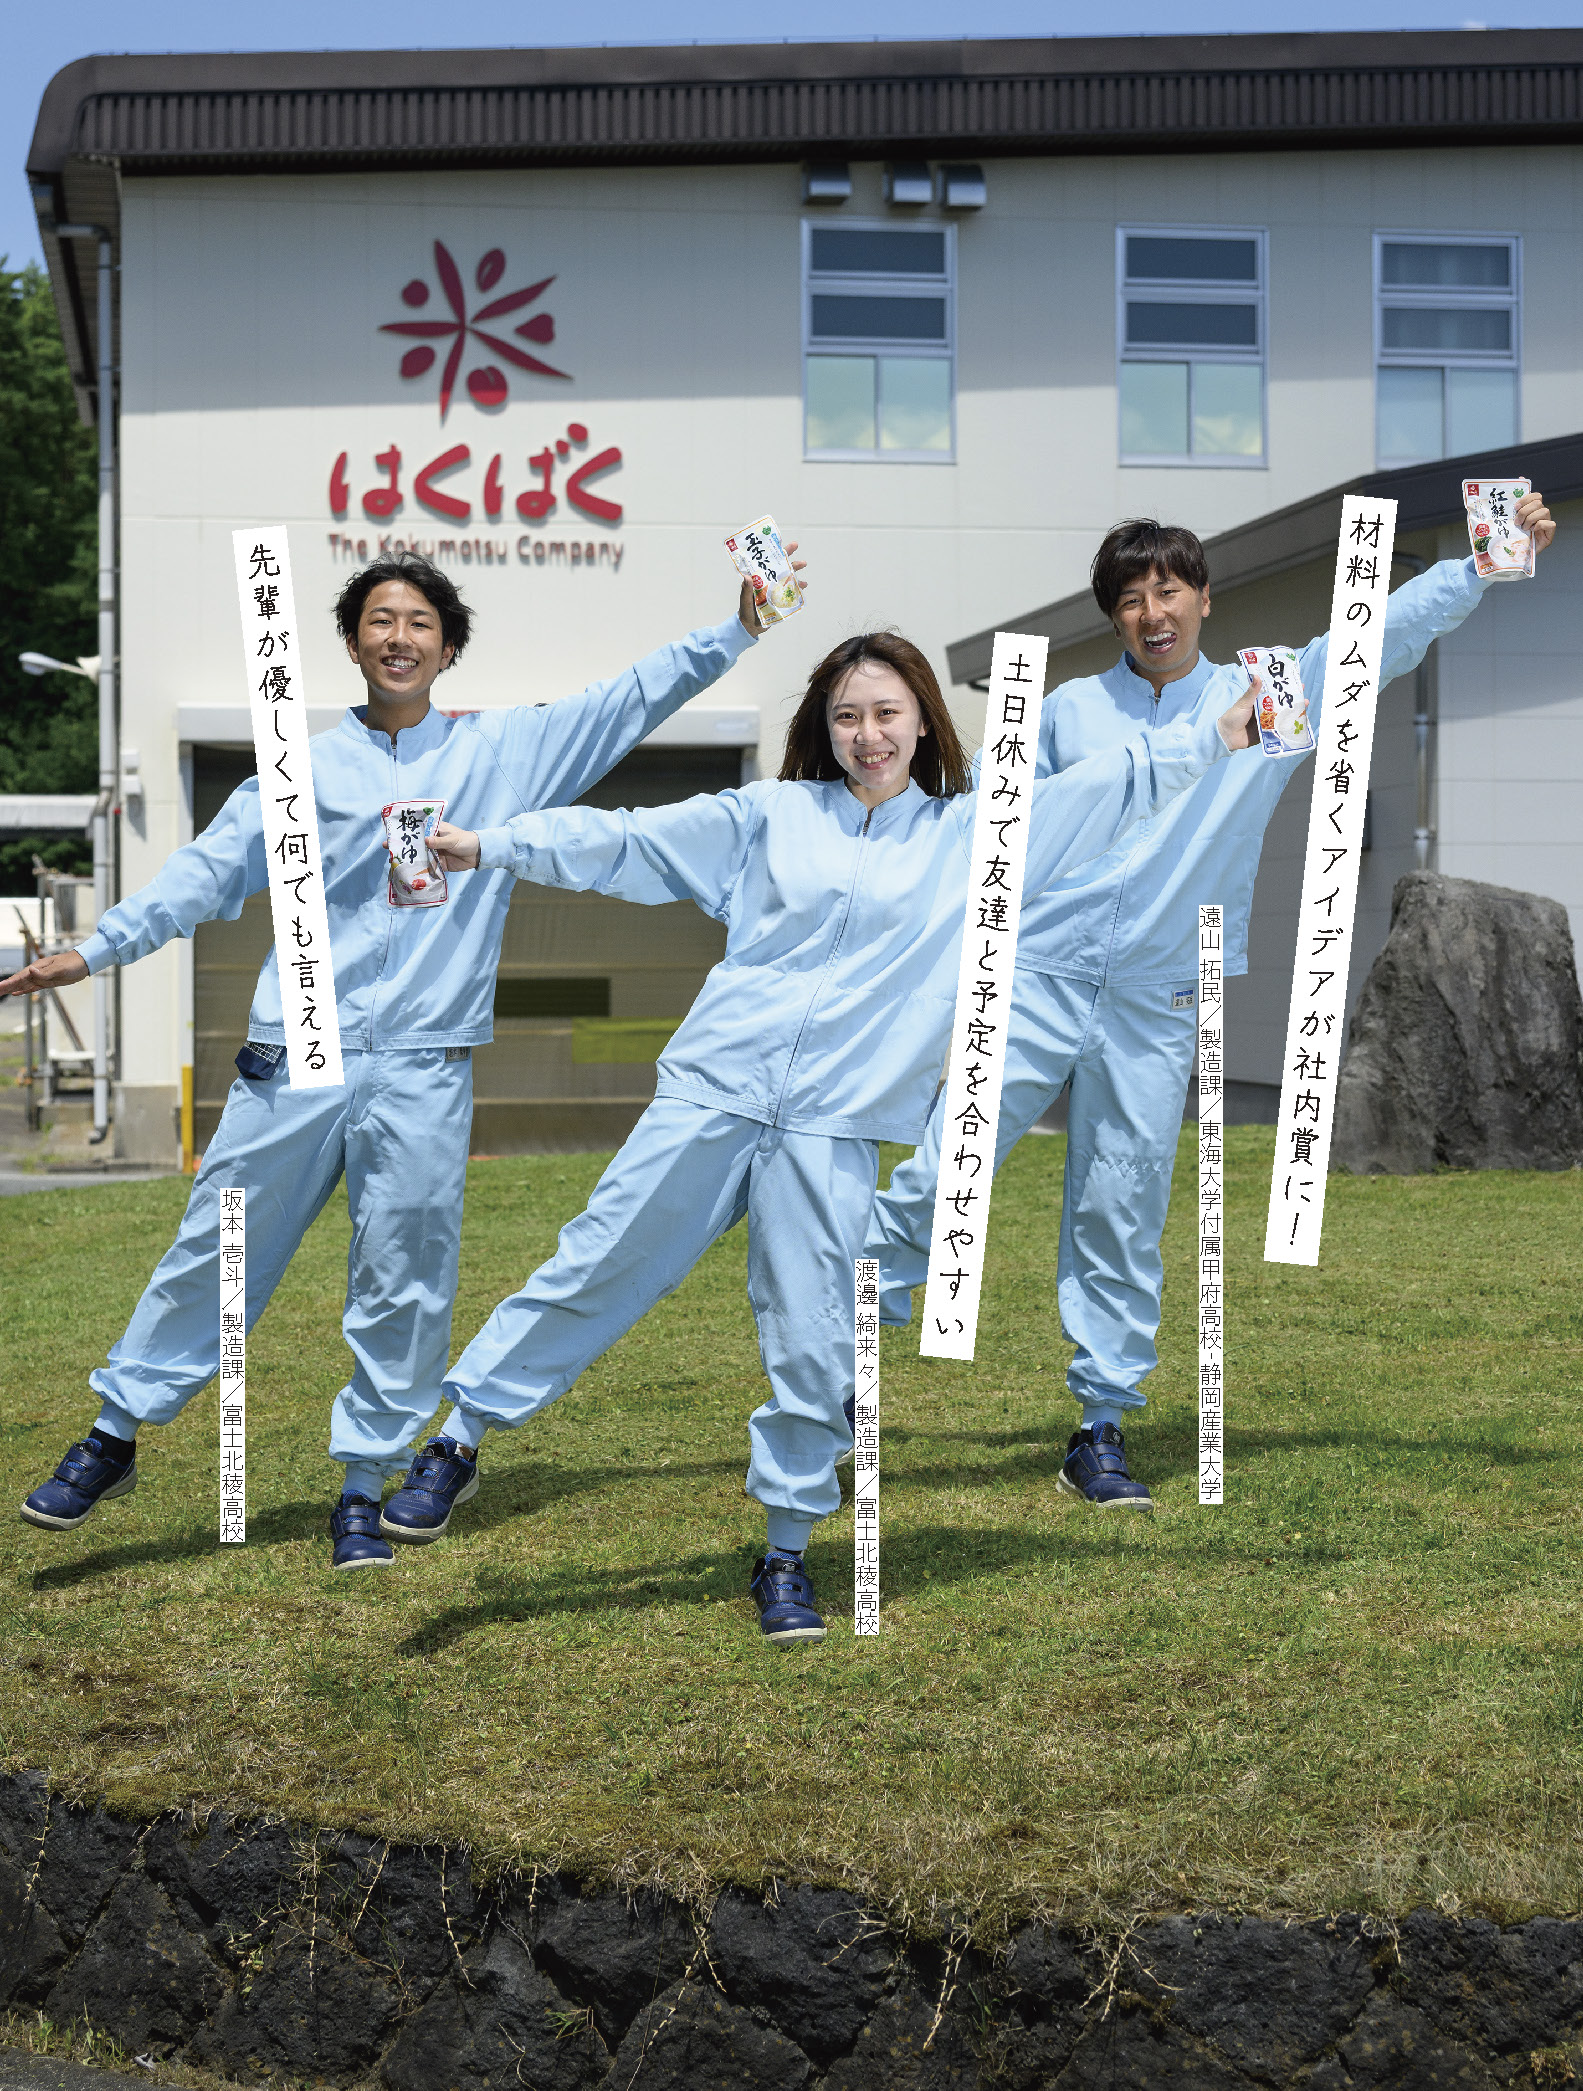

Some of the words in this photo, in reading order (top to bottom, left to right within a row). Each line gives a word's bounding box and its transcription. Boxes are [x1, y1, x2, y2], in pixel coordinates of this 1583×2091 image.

[329, 423, 623, 521] はくばく
[329, 533, 368, 558] The
[516, 534, 624, 565] Company
[1267, 653, 1294, 709] 白がゆ
[396, 807, 424, 864] 梅がゆ
